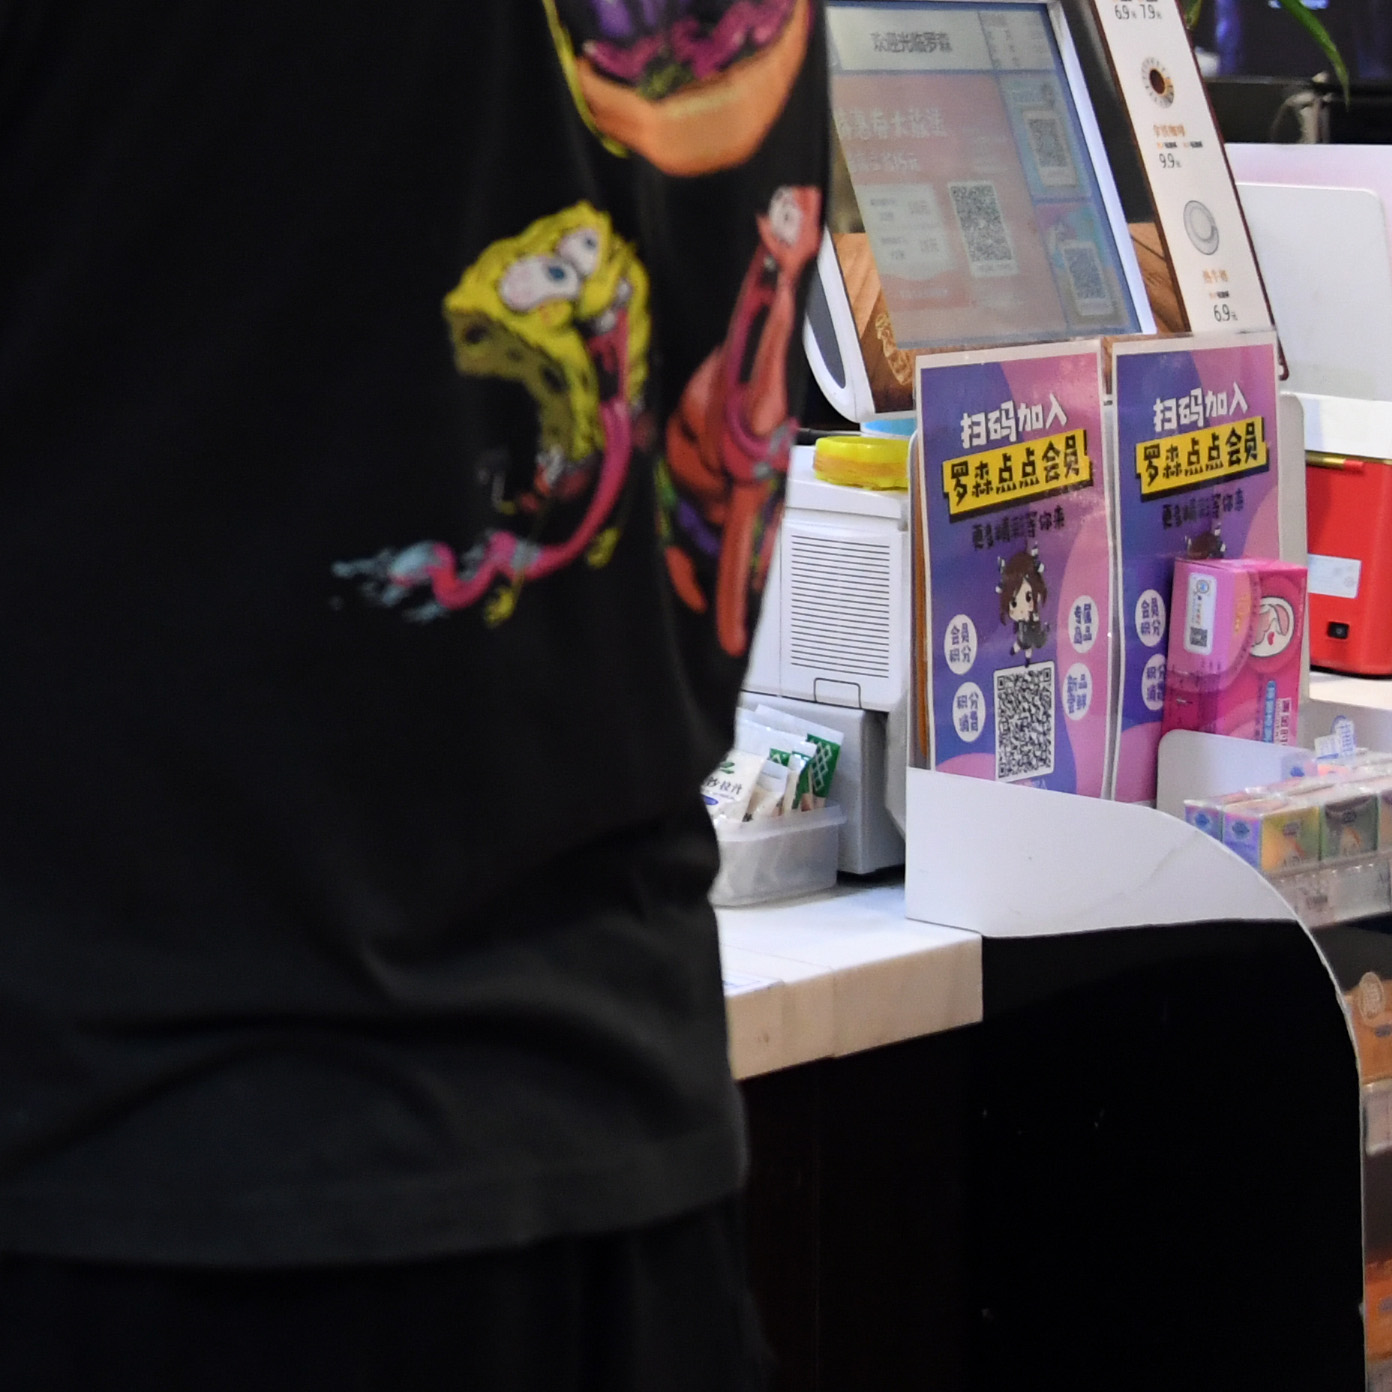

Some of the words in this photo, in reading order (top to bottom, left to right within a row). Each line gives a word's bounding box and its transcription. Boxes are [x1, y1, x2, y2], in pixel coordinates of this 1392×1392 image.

[1153, 381, 1250, 433] 扫码加入
[960, 391, 1069, 449] 扫码加入
[1142, 419, 1258, 487] 罗森点点会员
[949, 433, 1080, 507] 罗森点点会员
[1141, 596, 1161, 618] 会员
[950, 624, 970, 645] 会员
[1140, 615, 1162, 637] 积分
[949, 643, 972, 664] 积分
[957, 692, 979, 711] 积分
[706, 775, 743, 796] 沙拉汁
